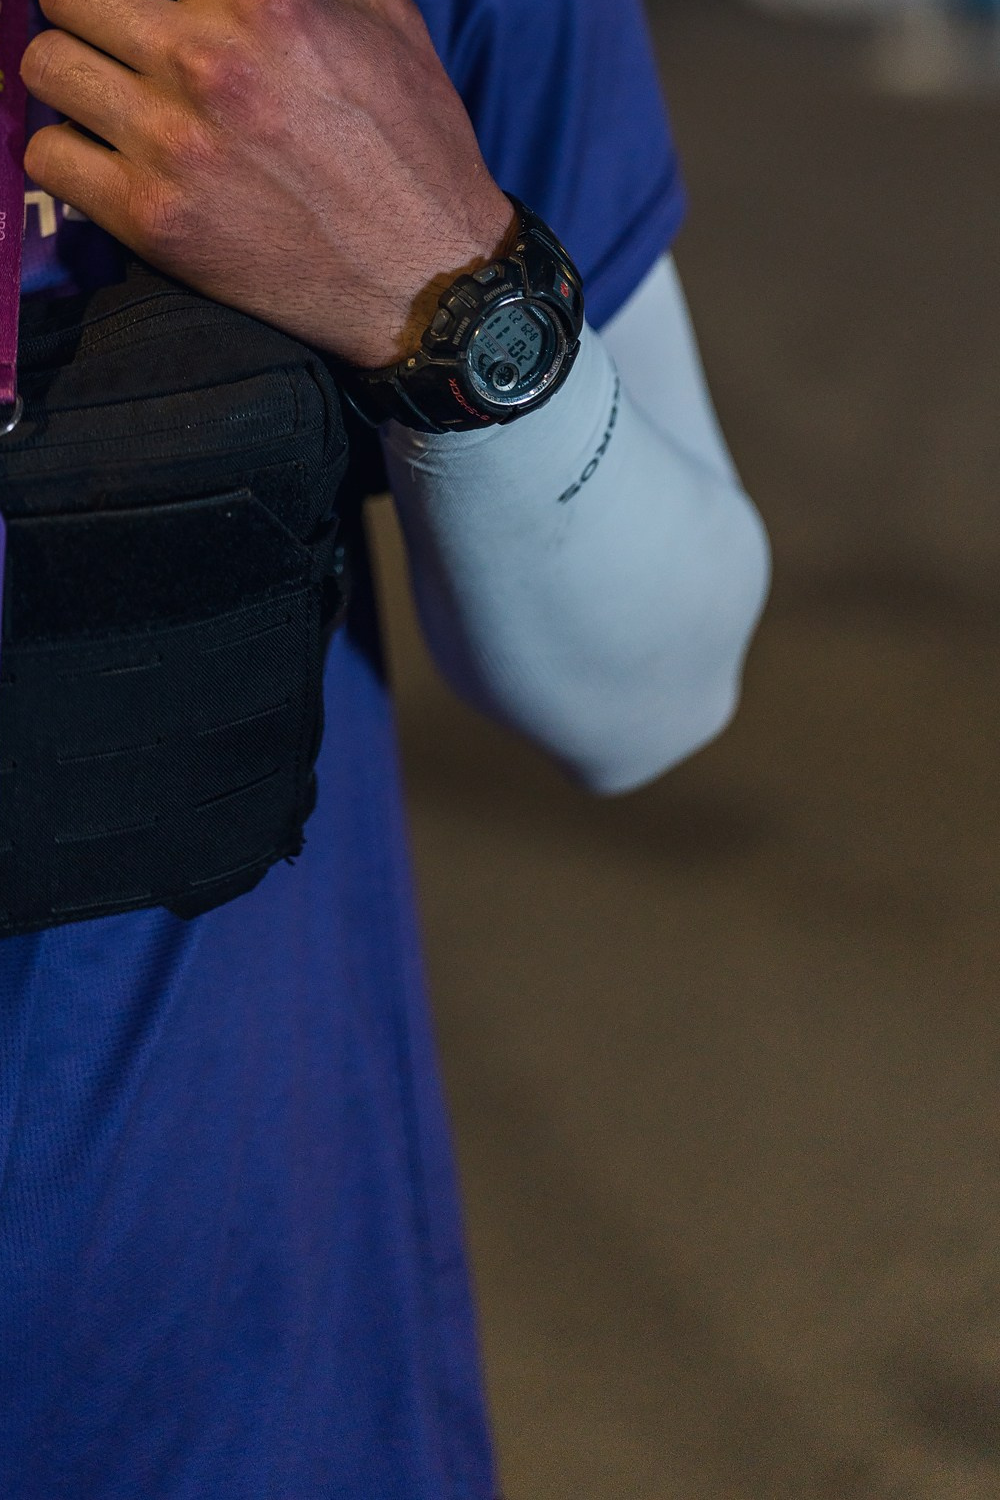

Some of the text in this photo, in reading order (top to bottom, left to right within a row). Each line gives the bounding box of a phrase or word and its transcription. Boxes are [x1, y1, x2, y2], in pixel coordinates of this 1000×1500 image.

[484, 282, 513, 302] FORWARD
[452, 316, 471, 346] REVERSE
[479, 335, 498, 354] FRI
[487, 316, 535, 366] 20:11
[448, 378, 490, 420] G-SHOCK
